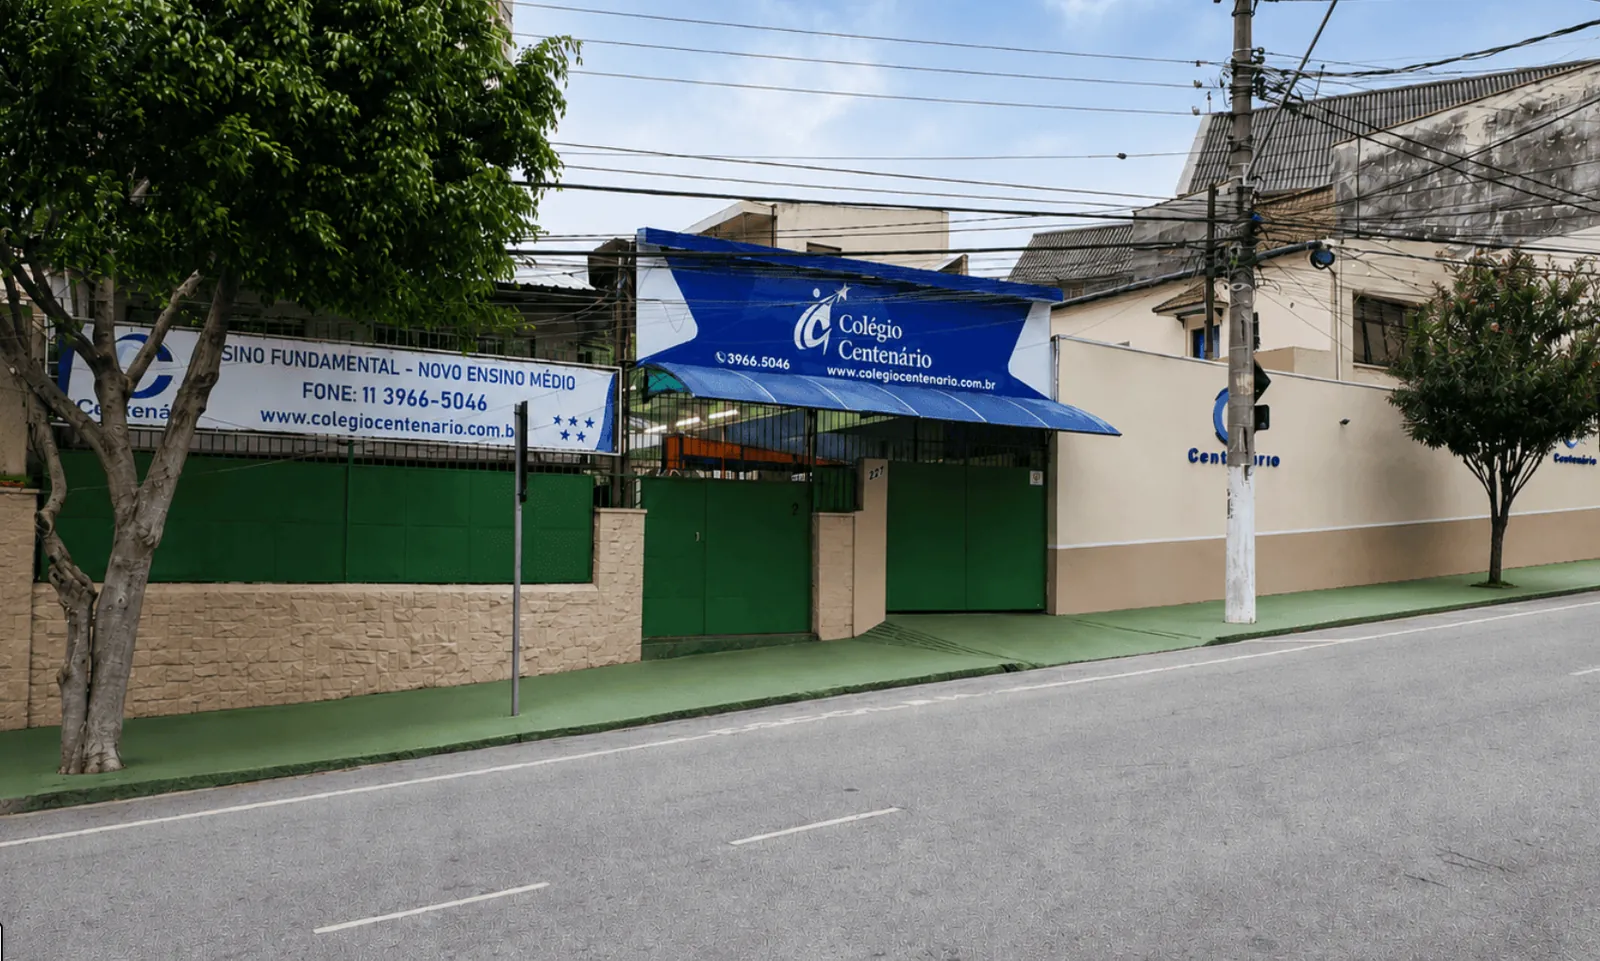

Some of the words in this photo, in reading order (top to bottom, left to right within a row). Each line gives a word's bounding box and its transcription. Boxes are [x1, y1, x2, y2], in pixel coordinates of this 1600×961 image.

[839, 314, 903, 343] Colégio
[221, 344, 265, 364] SINO
[271, 348, 400, 375] FUNDAMENTAL
[418, 361, 462, 381] NOVO
[467, 366, 525, 386] ENSINO
[530, 369, 576, 391] MÉDIO
[727, 352, 791, 370] 3966.5046
[838, 339, 932, 369] Centenário
[827, 366, 997, 390] www.colegiocentenario.com.br
[303, 381, 357, 403] FONE:
[362, 386, 376, 404] 11
[383, 387, 487, 411] 3966-5046
[260, 410, 515, 438] www.colegiocentenario.com.b
[1187, 447, 1280, 468] Centrio
